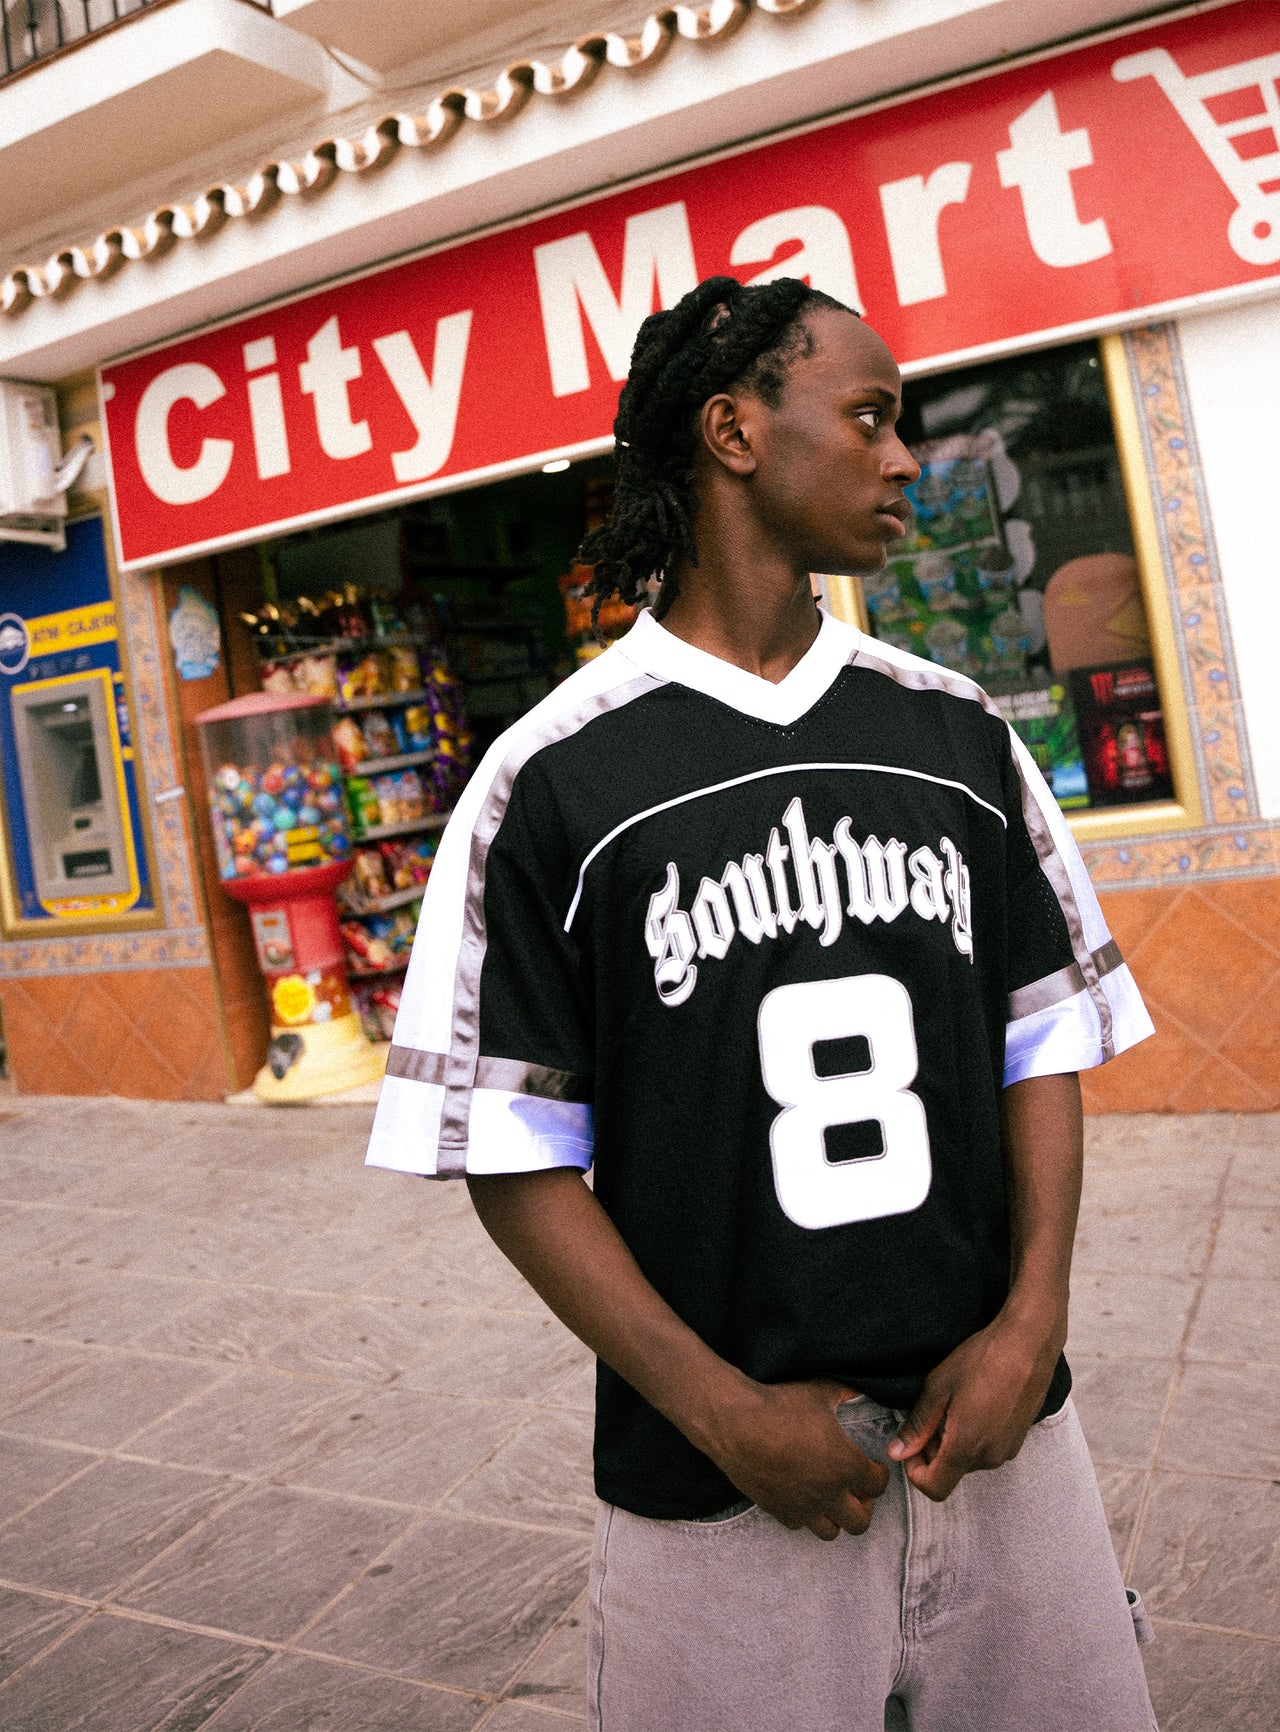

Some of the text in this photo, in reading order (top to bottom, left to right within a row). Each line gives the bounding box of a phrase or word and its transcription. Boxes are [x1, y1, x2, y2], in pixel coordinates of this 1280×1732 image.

[134, 89, 1114, 506] City Mart
[644, 796, 974, 1008] Southway
[757, 973, 932, 1230] 8
